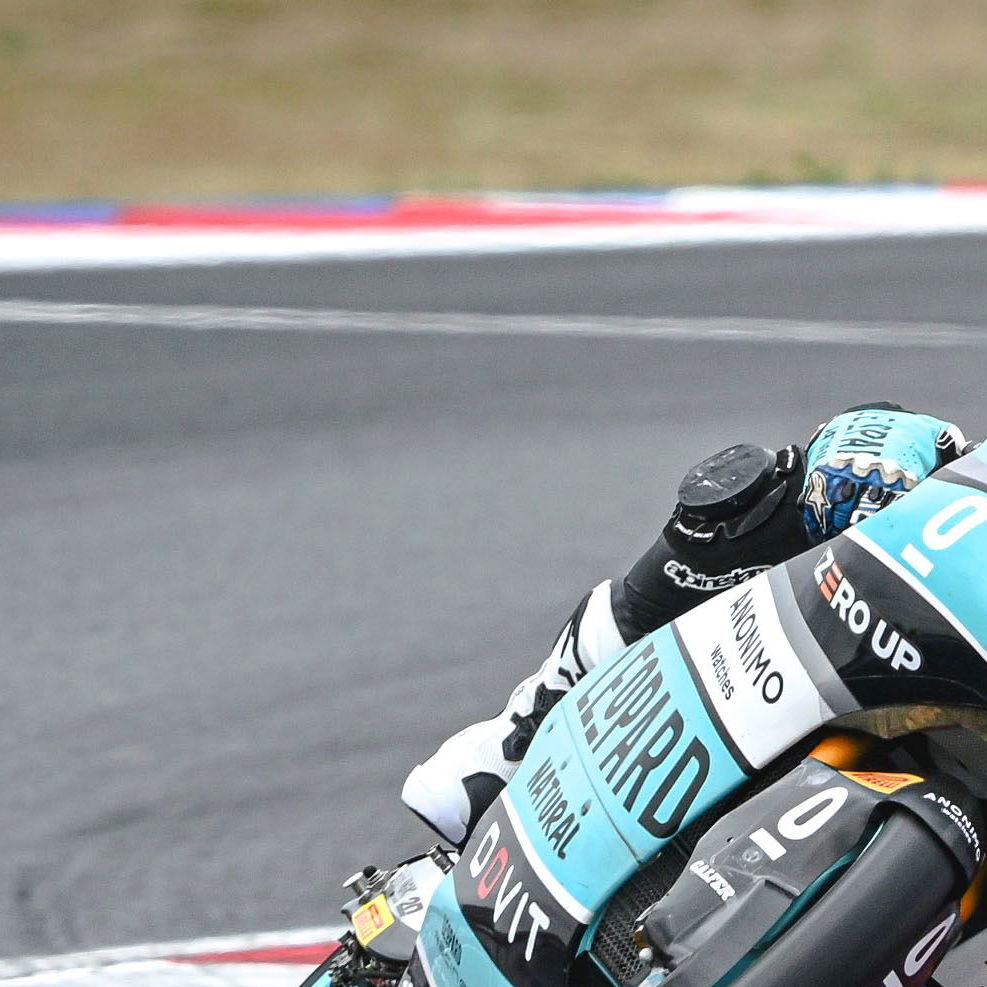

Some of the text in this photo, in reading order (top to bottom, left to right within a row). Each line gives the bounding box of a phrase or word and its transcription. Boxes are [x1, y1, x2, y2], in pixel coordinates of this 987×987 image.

[730, 588, 784, 704] ANONIMO
[813, 546, 922, 672] ZERO UP
[711, 644, 735, 700] watches
[576, 637, 711, 839] LEOPARD
[527, 758, 580, 860] NATURAL
[923, 792, 981, 862] ANONIMO
[470, 821, 550, 962] DOVIT
